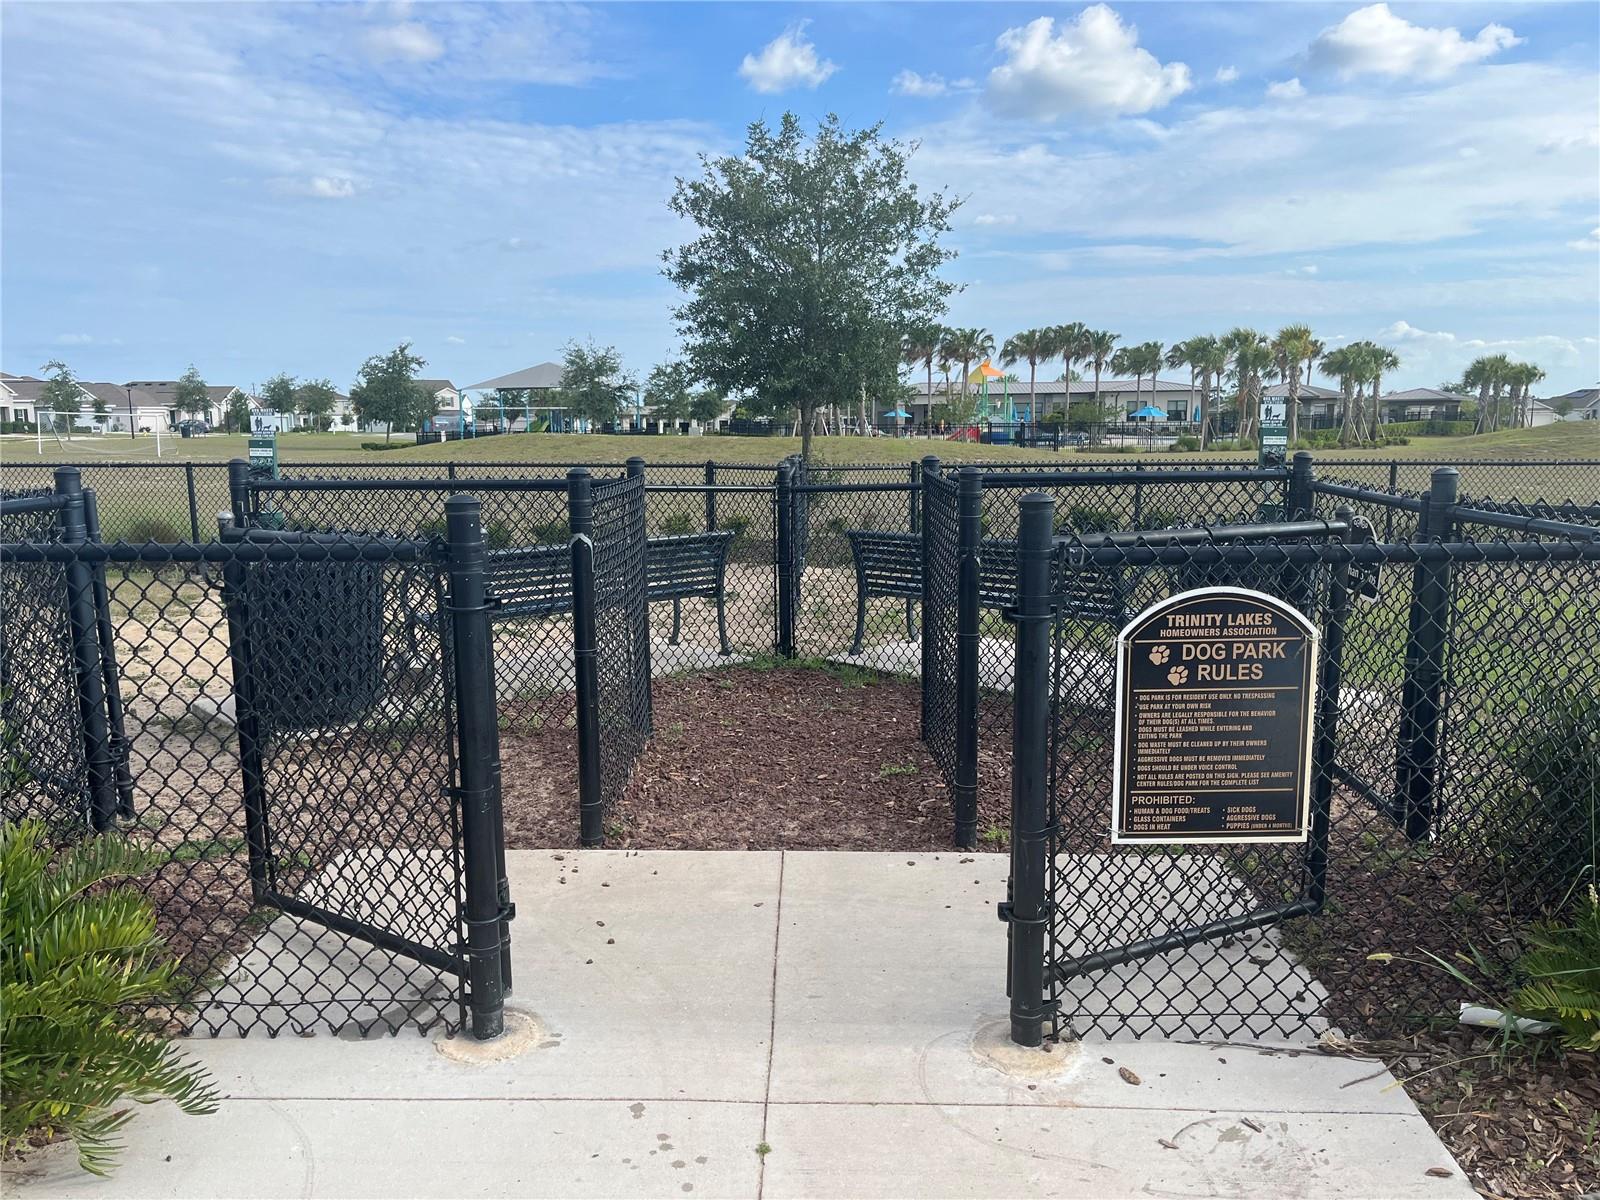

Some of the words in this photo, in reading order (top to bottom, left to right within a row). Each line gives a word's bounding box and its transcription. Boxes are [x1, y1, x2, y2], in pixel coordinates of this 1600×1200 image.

[1166, 614, 1223, 627] TRINITY
[1228, 613, 1273, 626] LAKES
[1160, 628, 1221, 638] HOMEOWNERS
[1222, 627, 1277, 636] ASSOCIATION
[1182, 643, 1226, 661] DOG
[1232, 642, 1286, 659] PARK
[1197, 664, 1263, 681] RULES
[1131, 795, 1196, 805] PROHIBITED:
